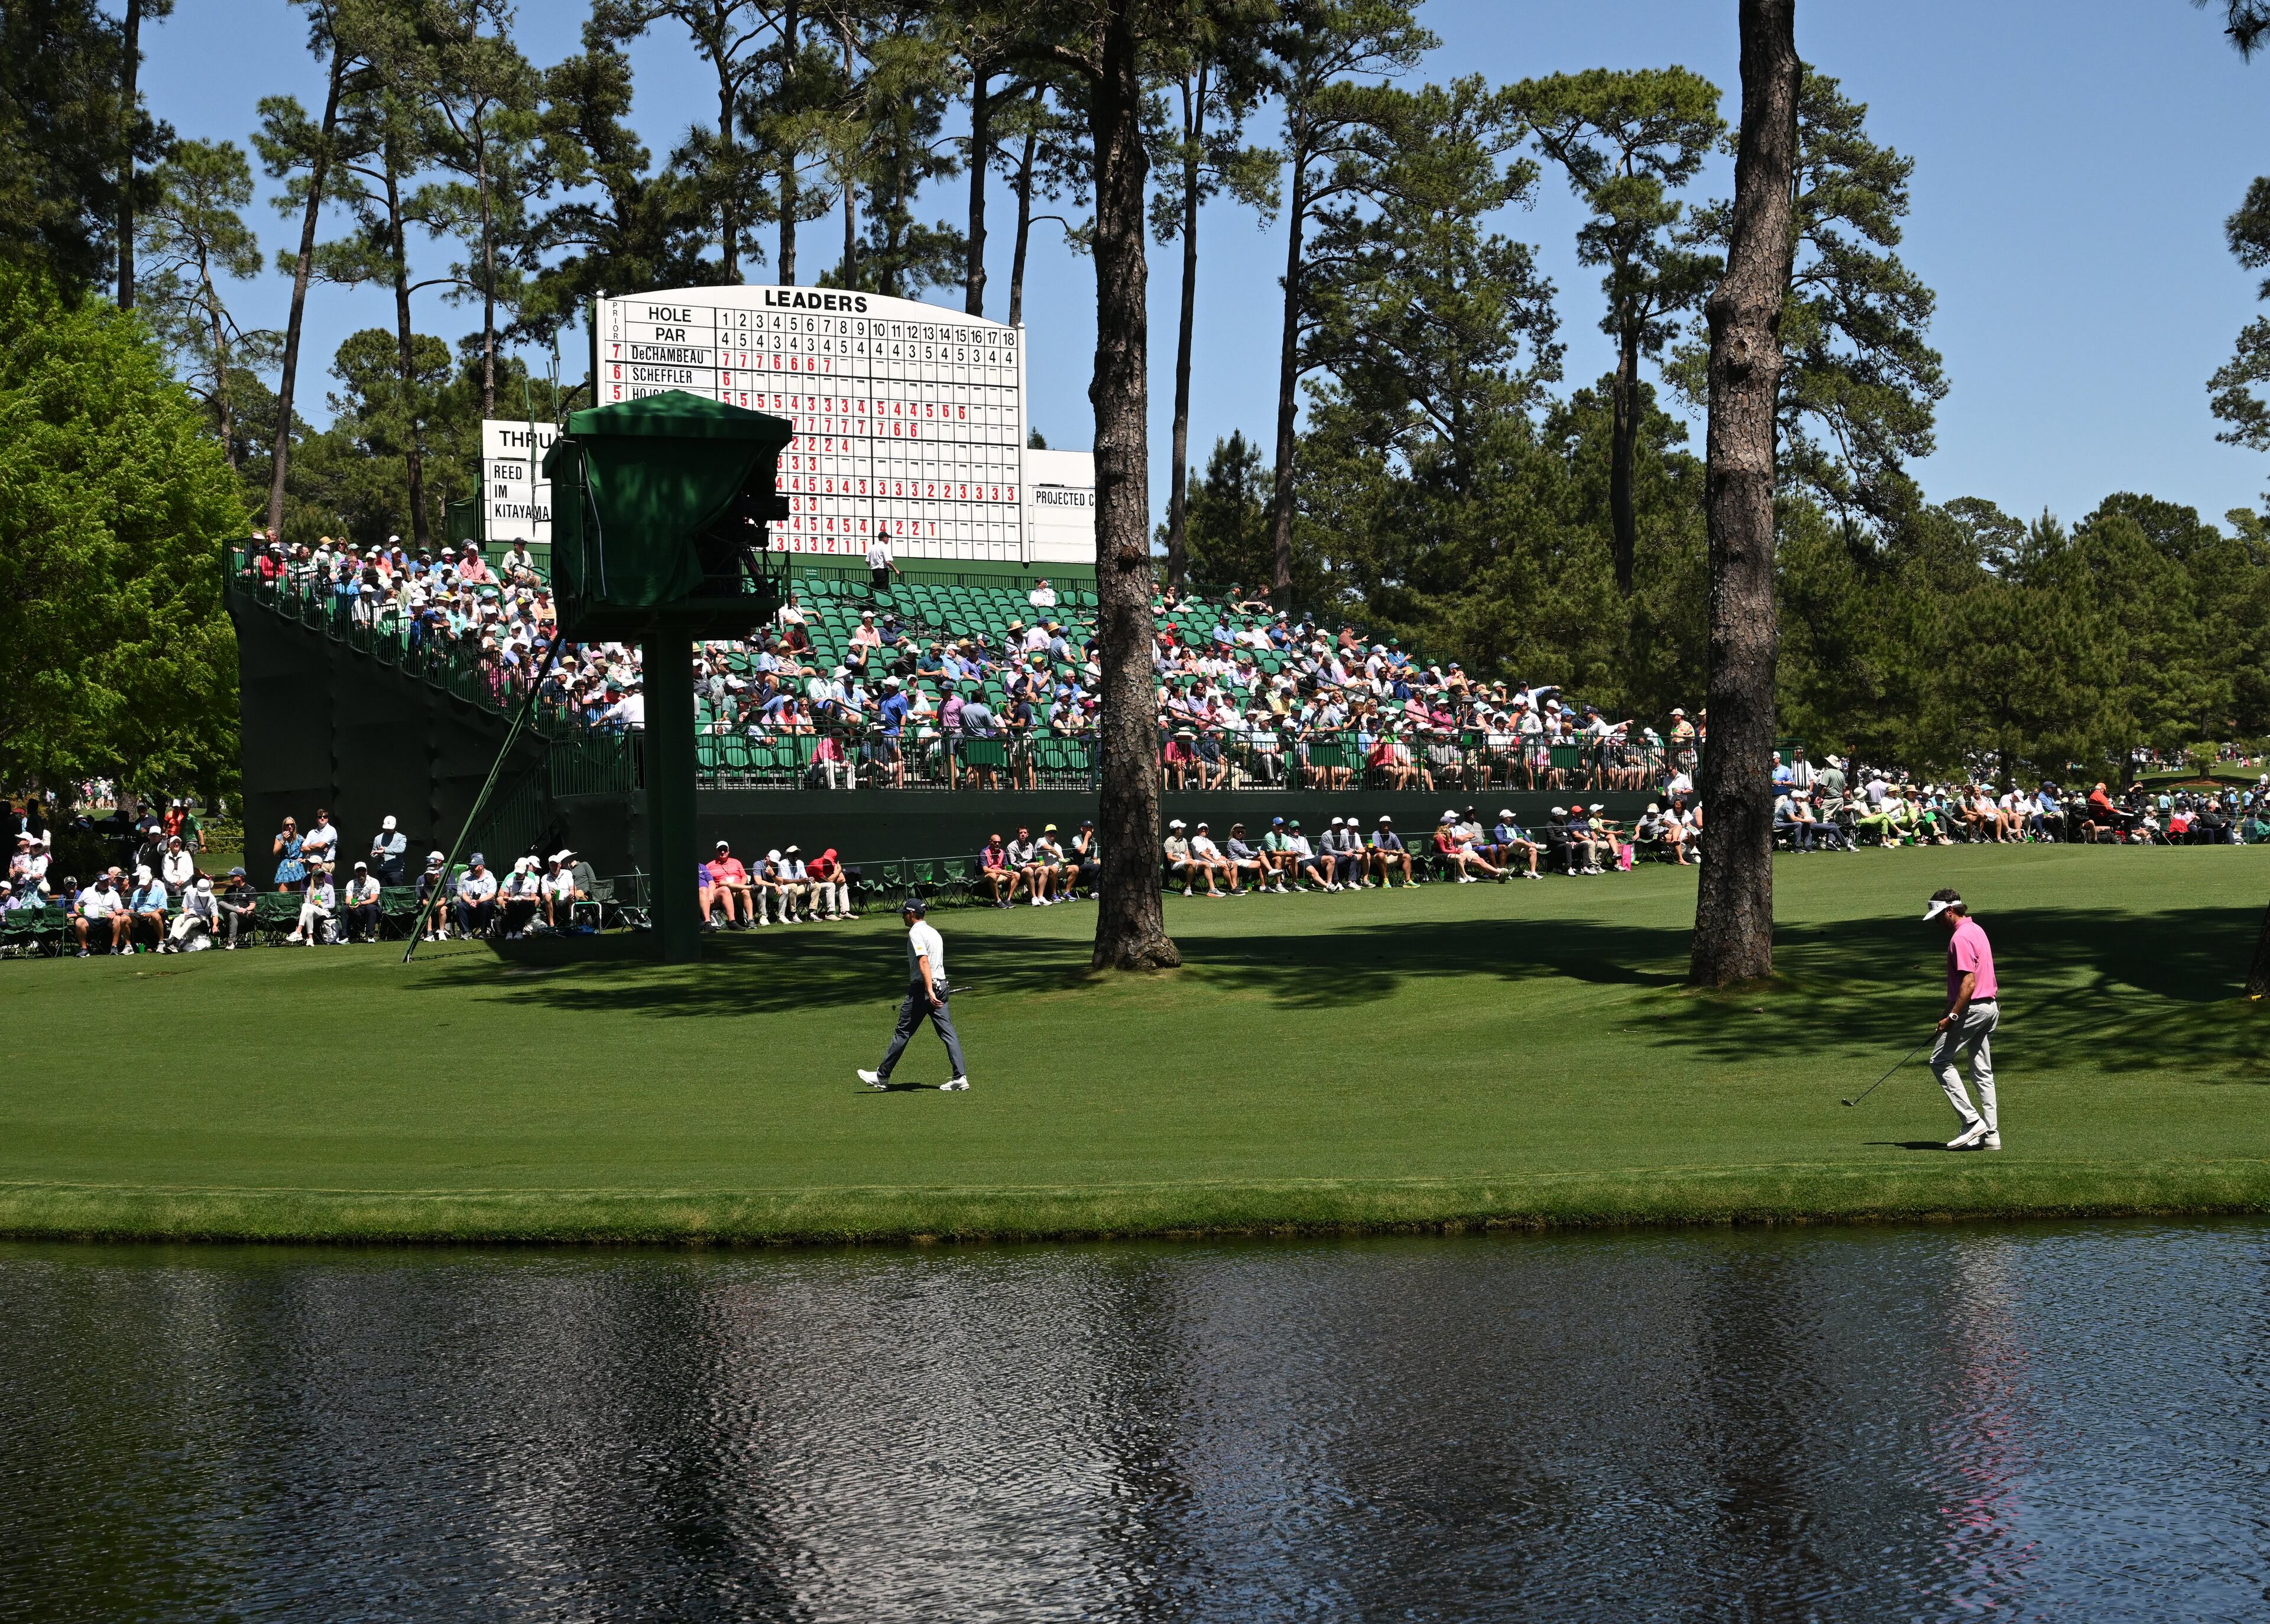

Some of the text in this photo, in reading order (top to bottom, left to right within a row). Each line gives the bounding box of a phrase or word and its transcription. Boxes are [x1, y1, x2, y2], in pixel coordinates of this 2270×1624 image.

[766, 289, 867, 313] LEADERS
[649, 306, 1014, 346] HOLE 1 2 3 4 5 6 7 8 9 10 11 12 13 14 15 16 17 18
[656, 328, 1013, 364] PAR 4 5 4 3 4 3 4 5 4 4 4 3 5 4 5 3 4 4
[612, 344, 831, 373] 7 DeCHAMBEAU 7 7 7 6 6 6 7
[613, 365, 731, 387] 6 SCHEFFLER 6
[613, 385, 621, 400] 5
[723, 392, 731, 405] 5
[740, 393, 748, 407] 5
[757, 394, 765, 409] 5
[774, 395, 782, 409] 5
[791, 396, 799, 410] 4
[808, 398, 816, 411] 3
[825, 398, 832, 413] 3
[841, 399, 849, 413] 3
[858, 400, 865, 414] 4
[877, 401, 885, 416] 5
[893, 402, 901, 416] 4
[910, 404, 917, 417] 4
[926, 404, 933, 418] 5
[942, 404, 950, 418] 6
[958, 406, 966, 420] 6
[791, 417, 917, 438] 7 7 7 7 7 7 6 6
[499, 430, 551, 449] THRU
[791, 436, 849, 453] 2 2 2 4
[494, 465, 522, 479] REED
[792, 455, 799, 470] 3
[809, 458, 816, 472] 3
[495, 485, 507, 498] IM
[775, 476, 1014, 501] 4 4 5 3 4 3 3 3 3 2 2 3 3 3 3
[792, 497, 816, 511] 3 3
[1036, 491, 1085, 506] PROJECTED
[495, 504, 549, 519] KITAYAMA
[793, 517, 801, 531] 4
[810, 518, 817, 531] 5
[826, 518, 834, 533] 4
[843, 518, 851, 533] 5
[860, 520, 867, 533] 4
[879, 520, 887, 533] 4
[896, 521, 903, 535] 2
[912, 521, 919, 536] 2
[929, 523, 935, 536] 1
[777, 537, 866, 554] 3 3 3 2 1 1
